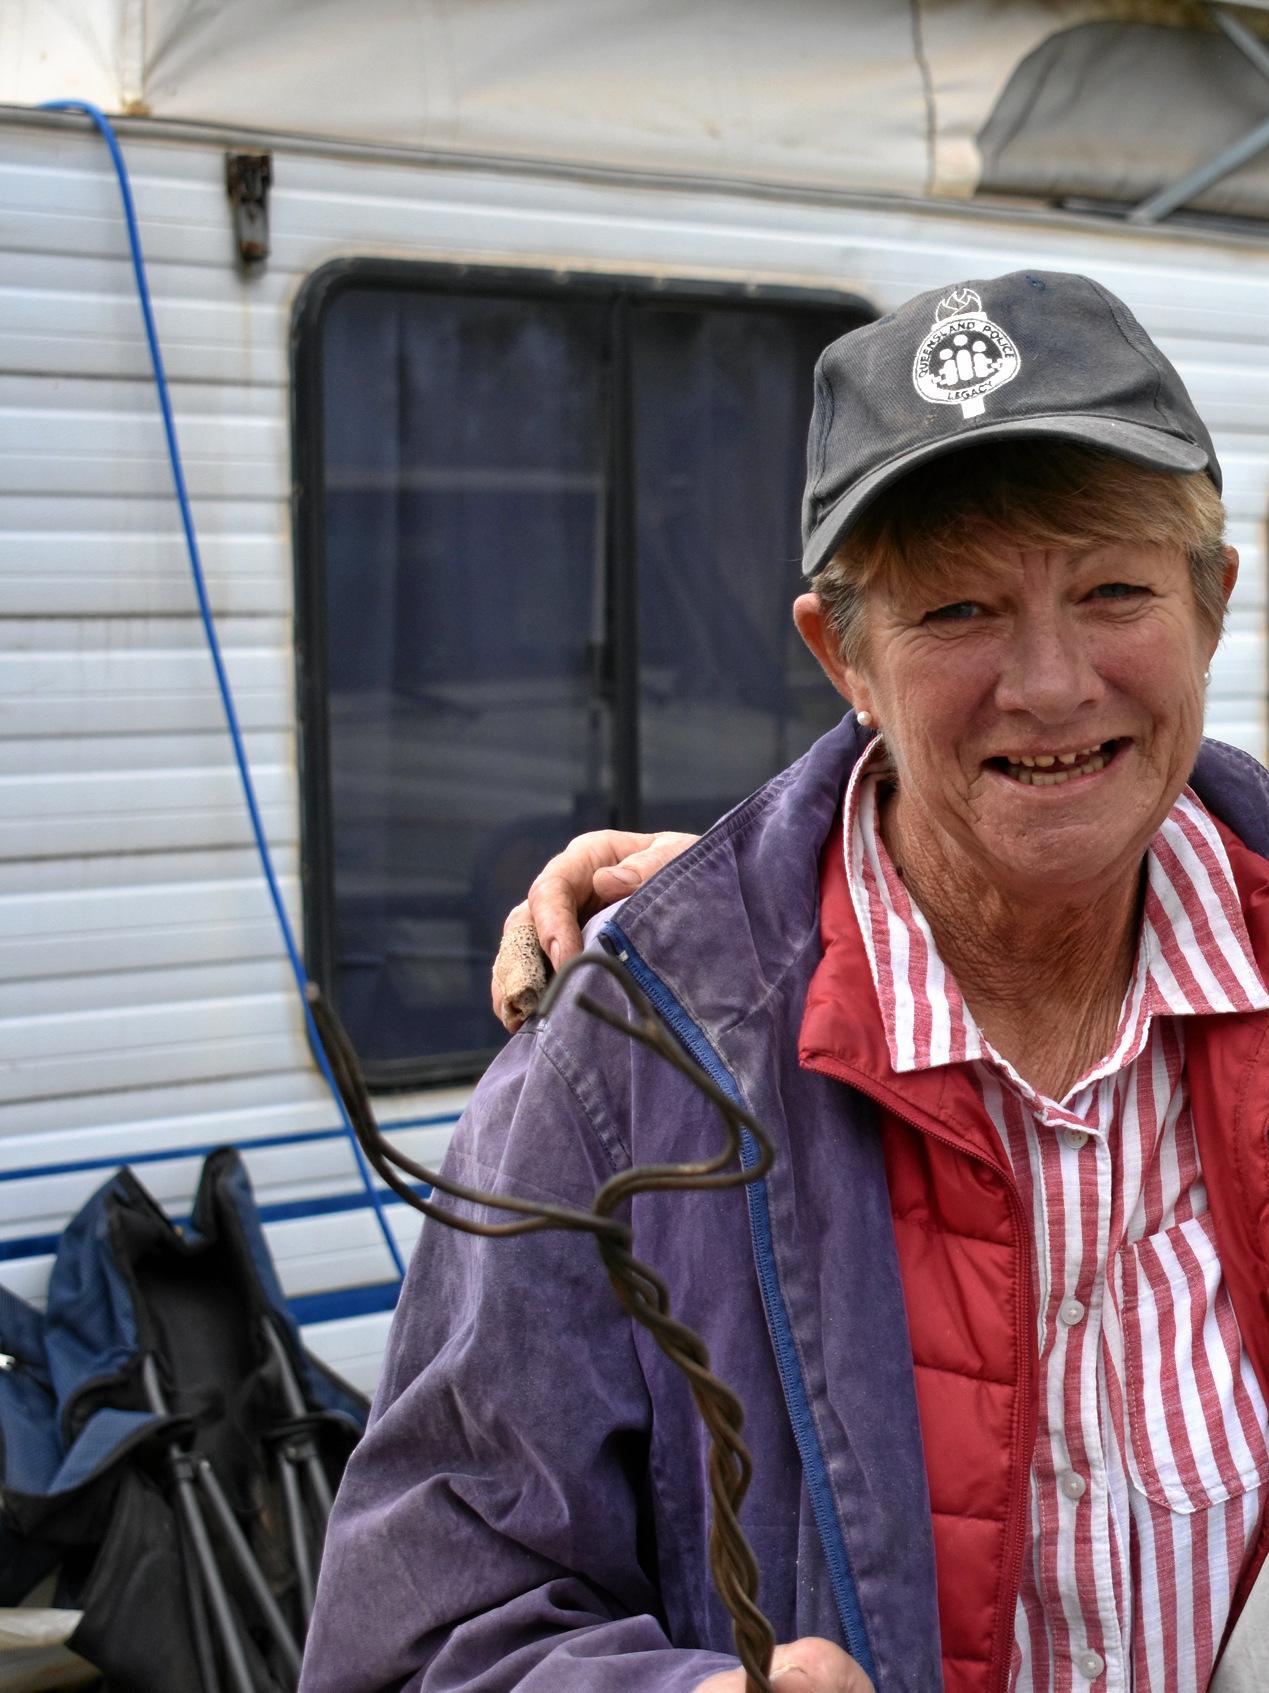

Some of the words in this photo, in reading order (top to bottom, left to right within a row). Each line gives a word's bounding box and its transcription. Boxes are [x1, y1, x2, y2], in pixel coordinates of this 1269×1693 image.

[919, 322, 975, 378] QUEENSLAND
[983, 325, 1014, 358] POLICE
[948, 381, 992, 399] LEGACY
